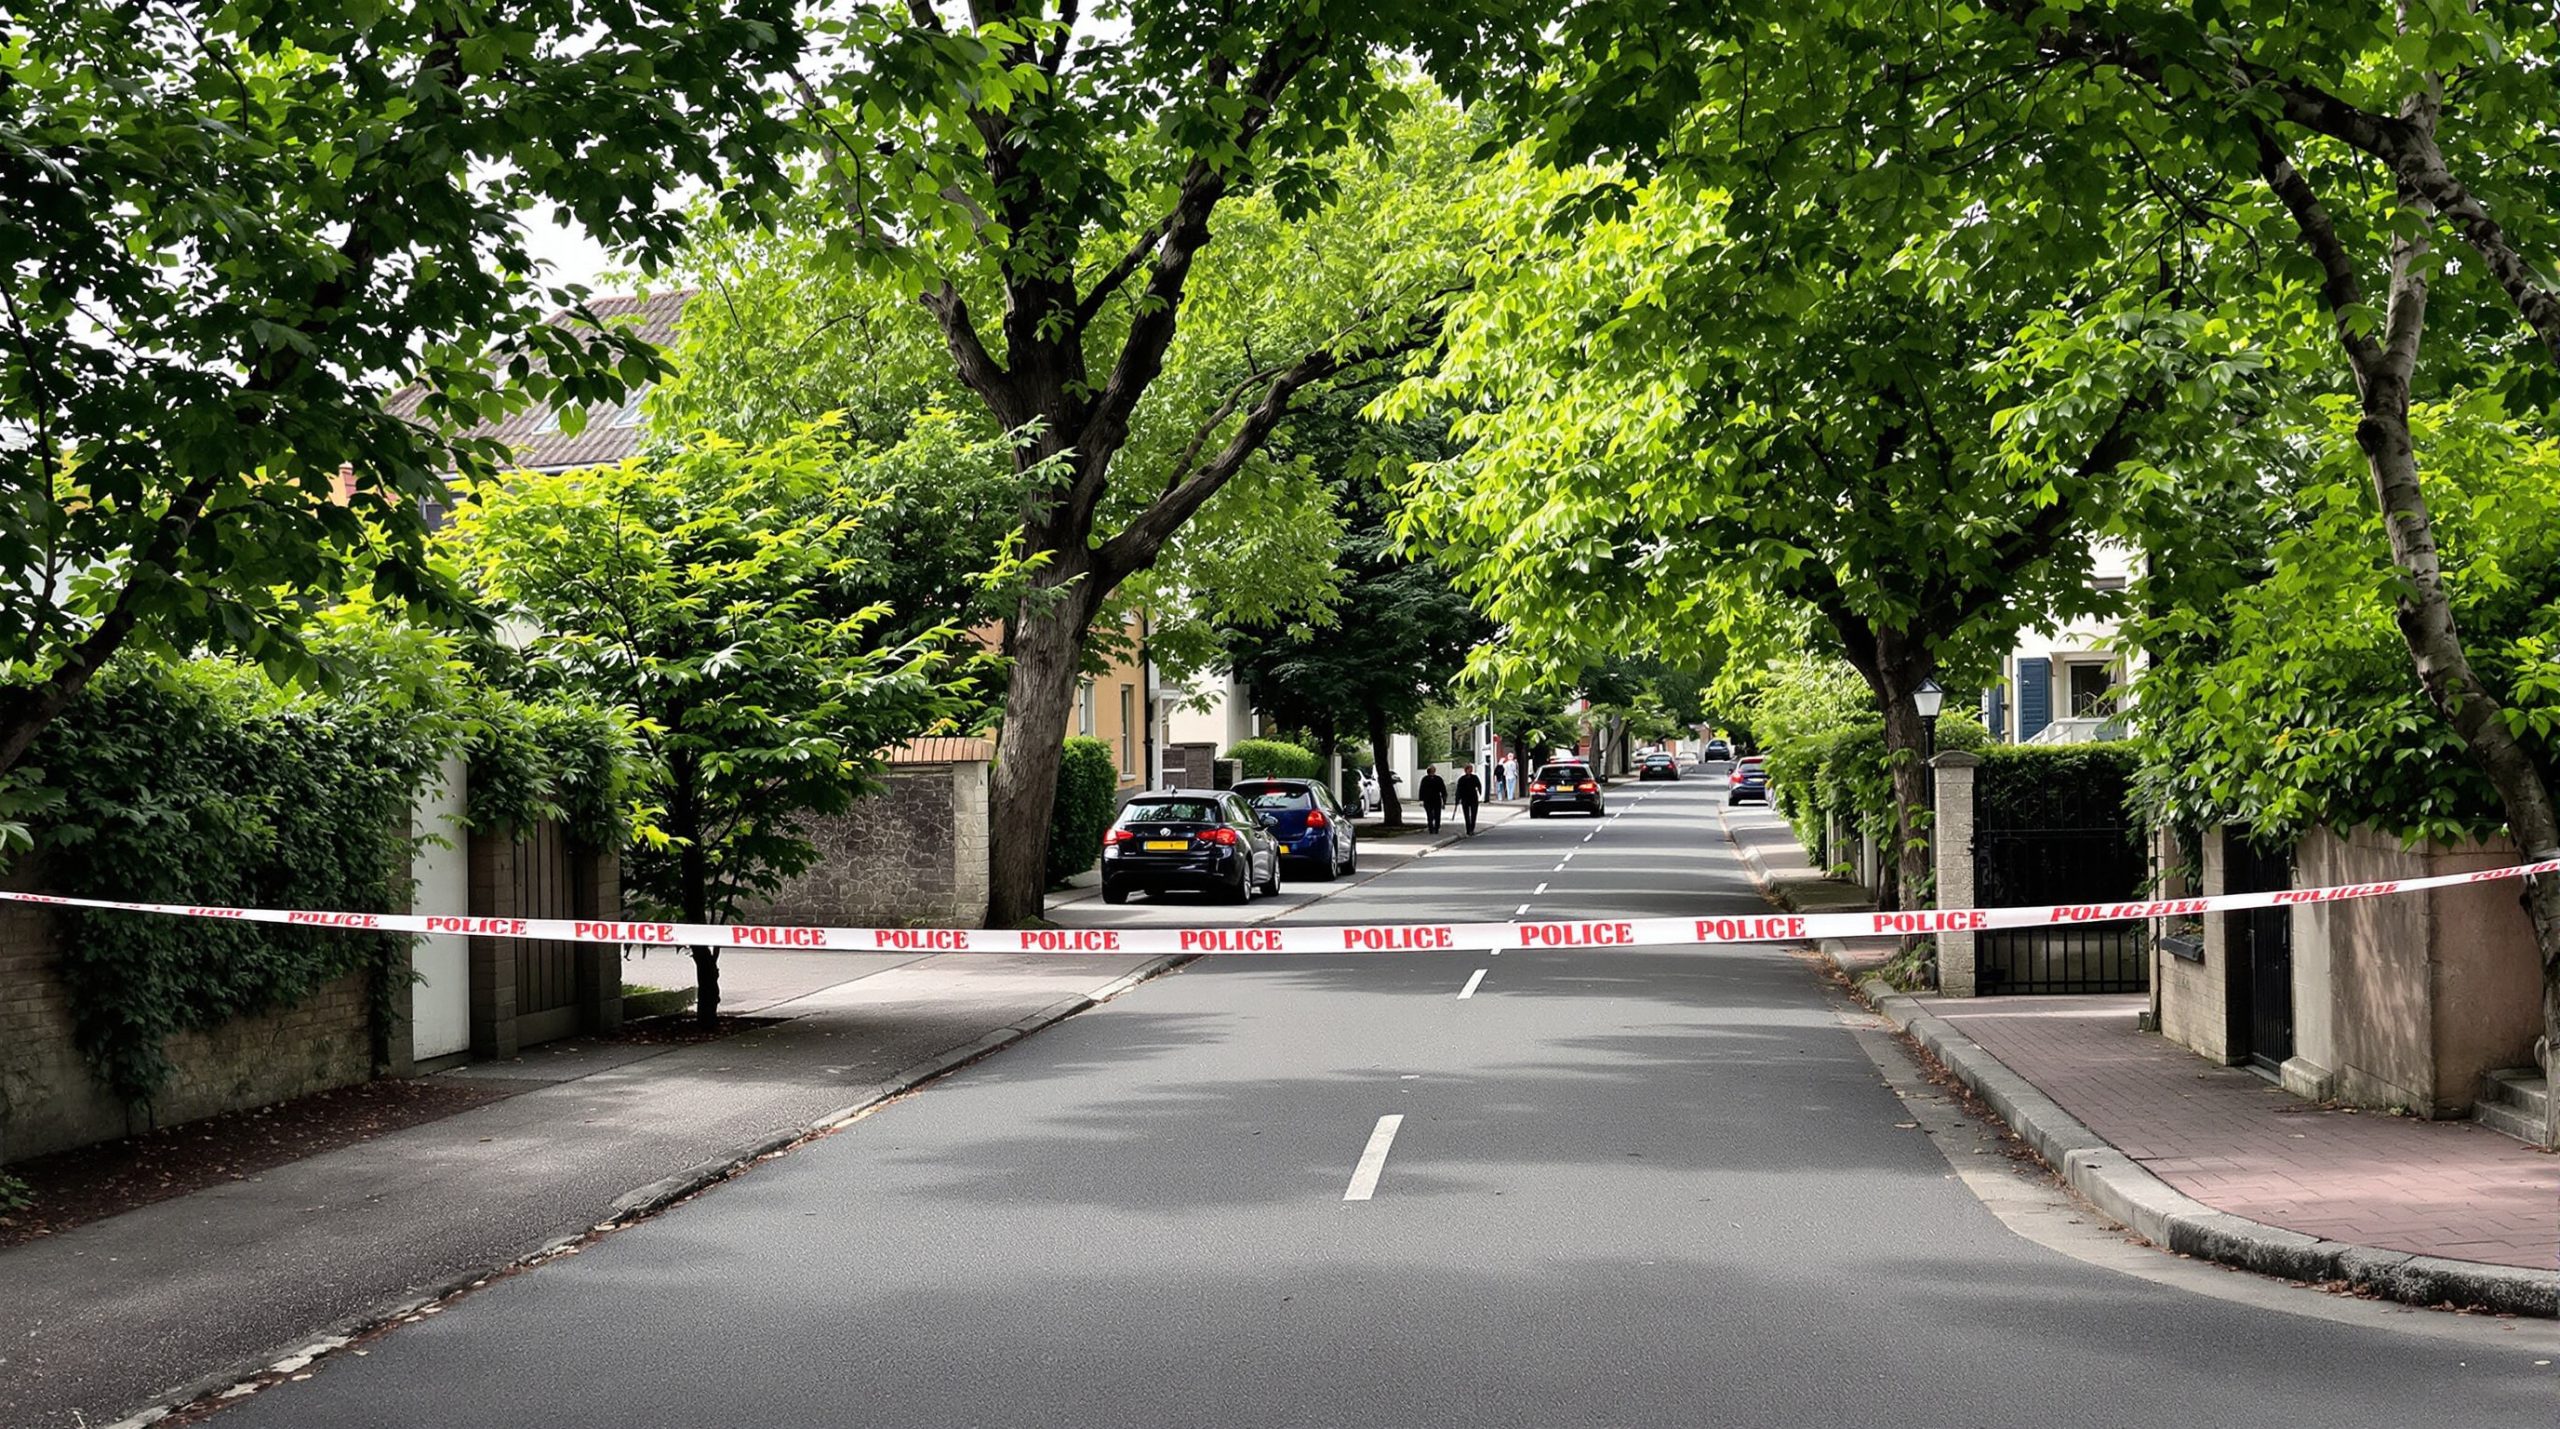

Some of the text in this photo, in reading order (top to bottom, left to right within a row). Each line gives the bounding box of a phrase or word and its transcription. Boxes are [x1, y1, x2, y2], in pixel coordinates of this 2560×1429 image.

[427, 917, 527, 935] POLICE
[575, 922, 674, 942] POLICE
[732, 927, 826, 946] POLICE
[875, 930, 969, 949] POLICE
[1020, 931, 1120, 951] POLICE
[1180, 929, 1284, 951] POLICE
[1344, 927, 1454, 949] POLICE
[1520, 923, 1634, 946] POLICE
[1695, 917, 1807, 942] POLICE
[1873, 912, 1987, 933] POLICE
